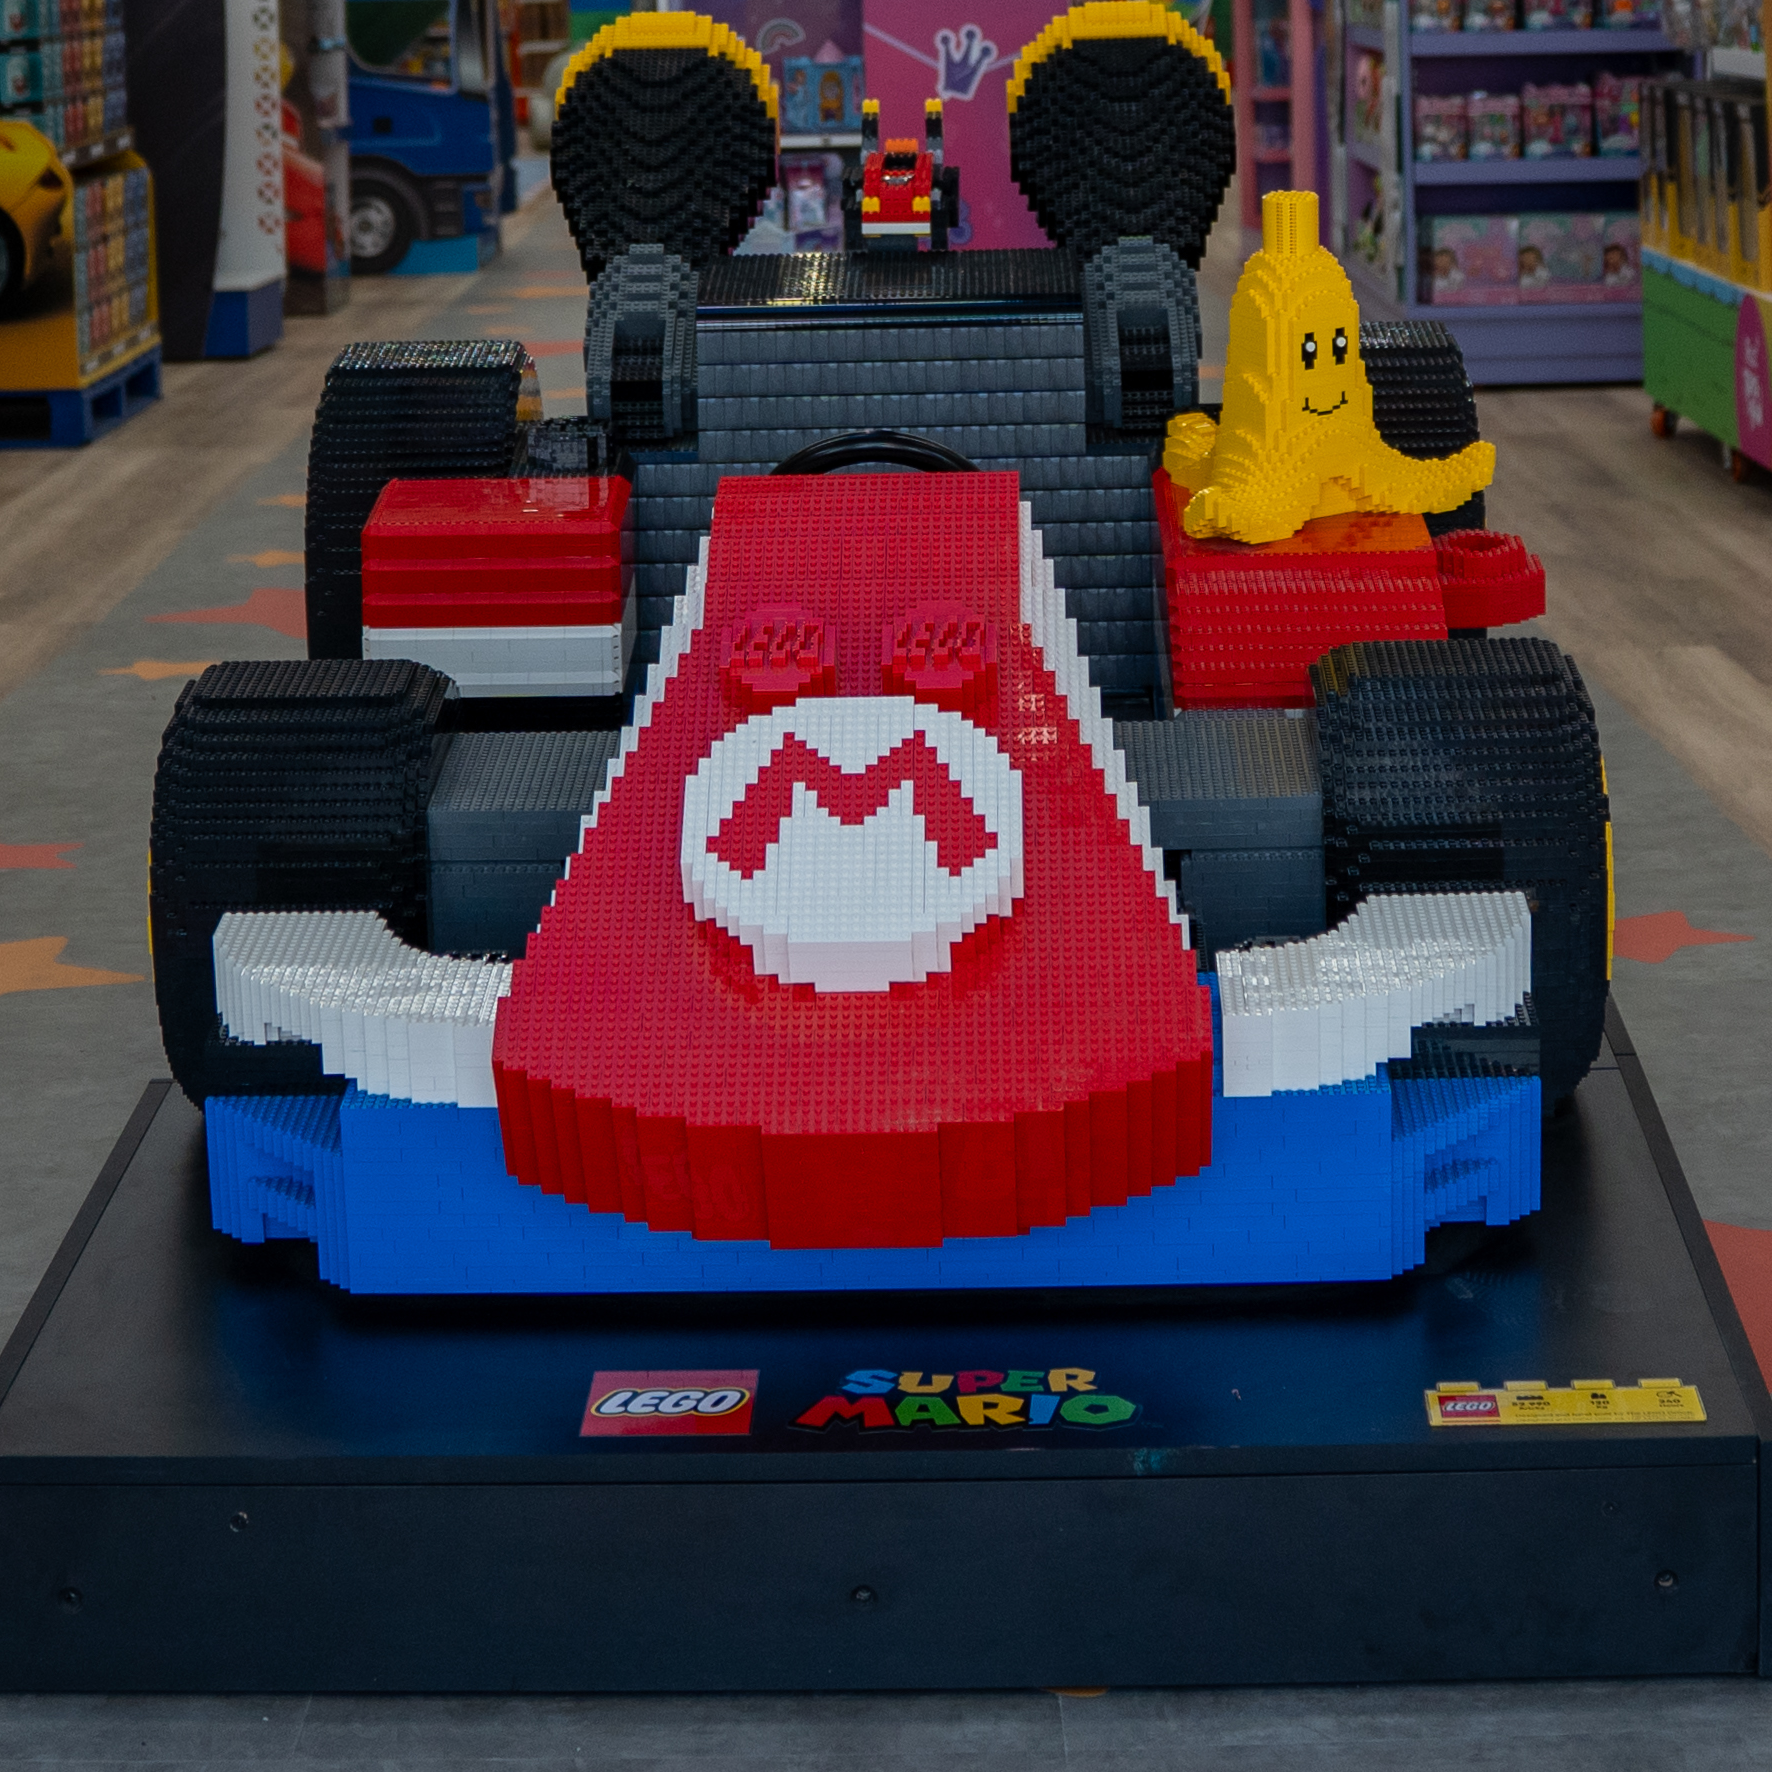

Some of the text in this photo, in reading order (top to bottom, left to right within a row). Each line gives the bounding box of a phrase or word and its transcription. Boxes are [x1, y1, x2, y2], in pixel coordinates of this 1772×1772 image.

[706, 729, 999, 879] M
[840, 1366, 1097, 1395] SUPER
[596, 1390, 746, 1416] LEGO
[793, 1394, 1137, 1428] MARIO
[1443, 1400, 1494, 1412] LEGO
